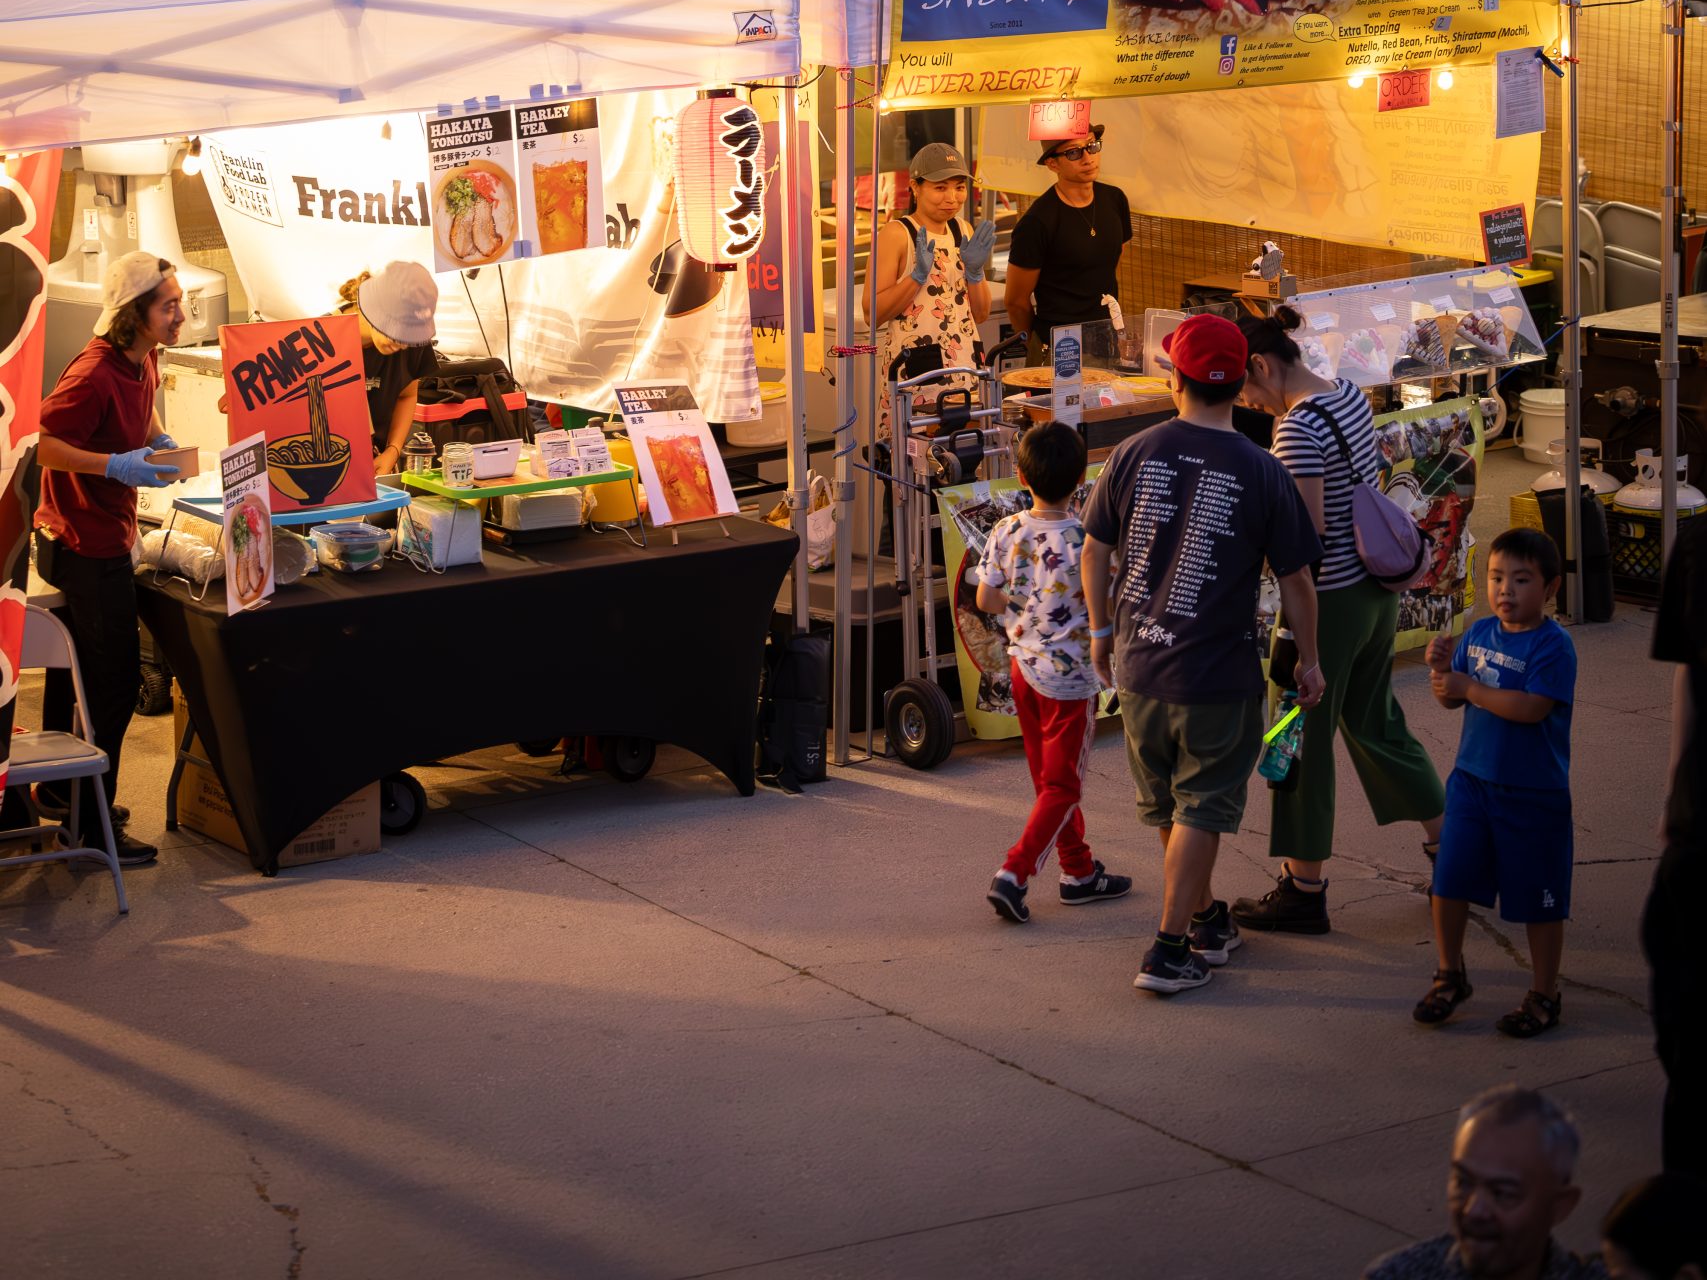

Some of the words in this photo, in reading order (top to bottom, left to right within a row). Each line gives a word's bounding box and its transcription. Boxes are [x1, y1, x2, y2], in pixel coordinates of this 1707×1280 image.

[1368, 11, 1381, 19] with
[1388, 8, 1411, 18] Green
[1411, 7, 1426, 16] Tea
[1426, 6, 1439, 16] Ice
[1439, 4, 1461, 14] Cream
[989, 21, 1007, 30] Since
[1007, 19, 1023, 29] 2011
[1313, 20, 1329, 28] want
[1338, 24, 1361, 37] Extra
[1363, 21, 1401, 35] Topping
[1114, 32, 1163, 47] SASUKE
[1243, 43, 1256, 51] Like
[1264, 42, 1285, 50] Follow
[1347, 40, 1380, 54] Nutella,
[1382, 39, 1397, 50] Red
[1399, 36, 1423, 49] Bean,
[1425, 33, 1449, 45] Fruits,
[1451, 29, 1497, 42] Shiratama
[1498, 24, 1530, 39] (Mochi),
[899, 52, 927, 69] You
[931, 51, 953, 67] will
[1116, 52, 1142, 64] What
[1143, 51, 1154, 61] the
[1155, 48, 1195, 60] difference
[1258, 53, 1292, 62] information
[1293, 51, 1311, 59] about
[1345, 53, 1372, 66] OREO,
[1374, 53, 1390, 65] any
[1391, 51, 1404, 61] Ice
[1405, 49, 1432, 60] Cream
[1433, 47, 1453, 62] (any
[1454, 43, 1483, 57] flavor)
[1151, 63, 1158, 72] is
[1249, 65, 1265, 73] other
[1266, 64, 1284, 72] events
[893, 71, 974, 97] NEVER
[979, 66, 1082, 92] REGRET!!
[1113, 75, 1128, 85] the
[1128, 73, 1153, 84] TASTE
[1154, 72, 1163, 83] of
[1164, 69, 1190, 83] dough
[1381, 73, 1429, 98] ORDER
[519, 105, 571, 124] BARLEY
[1032, 102, 1085, 122] PICK-UP
[430, 116, 493, 137] HAKATA
[520, 121, 548, 136] TEA
[430, 130, 494, 149] TONKOTSU
[220, 149, 265, 172] Franklin
[224, 163, 246, 181] Food
[246, 170, 267, 185] Lab
[720, 105, 764, 257] ラーメン
[291, 174, 431, 227] Frankl
[605, 202, 641, 249] ab
[231, 319, 336, 411] RAMEN
[619, 389, 668, 402] BARLEY
[624, 401, 653, 412] TEA
[222, 449, 256, 476] HAKATA
[223, 463, 257, 488] TONKOTSU
